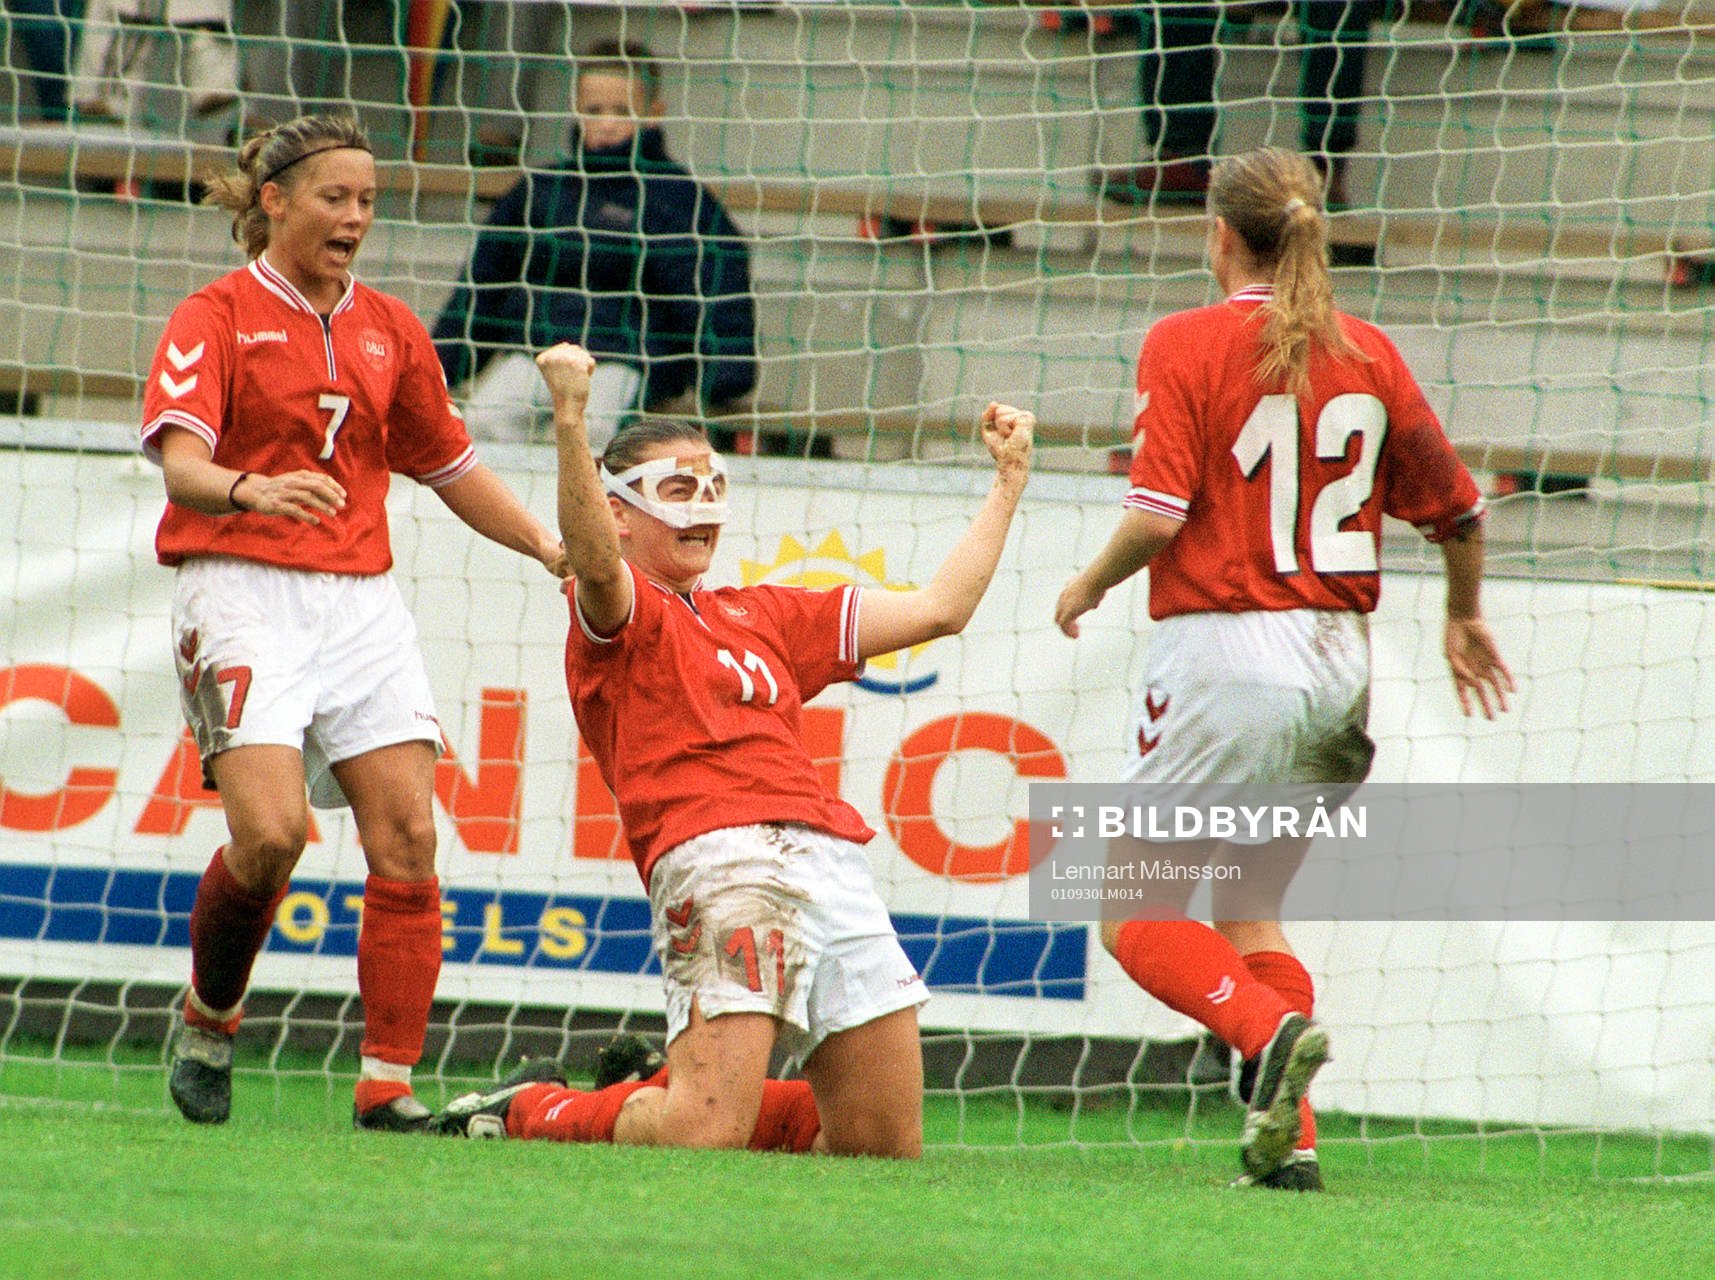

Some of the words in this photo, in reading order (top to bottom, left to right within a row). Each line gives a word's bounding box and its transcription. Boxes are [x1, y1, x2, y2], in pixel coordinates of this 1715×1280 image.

[236, 328, 289, 345] hummel
[317, 392, 351, 460] 7
[1230, 391, 1389, 576] 12
[216, 665, 253, 730] 7
[716, 648, 779, 706] 11
[724, 926, 785, 996] 11
